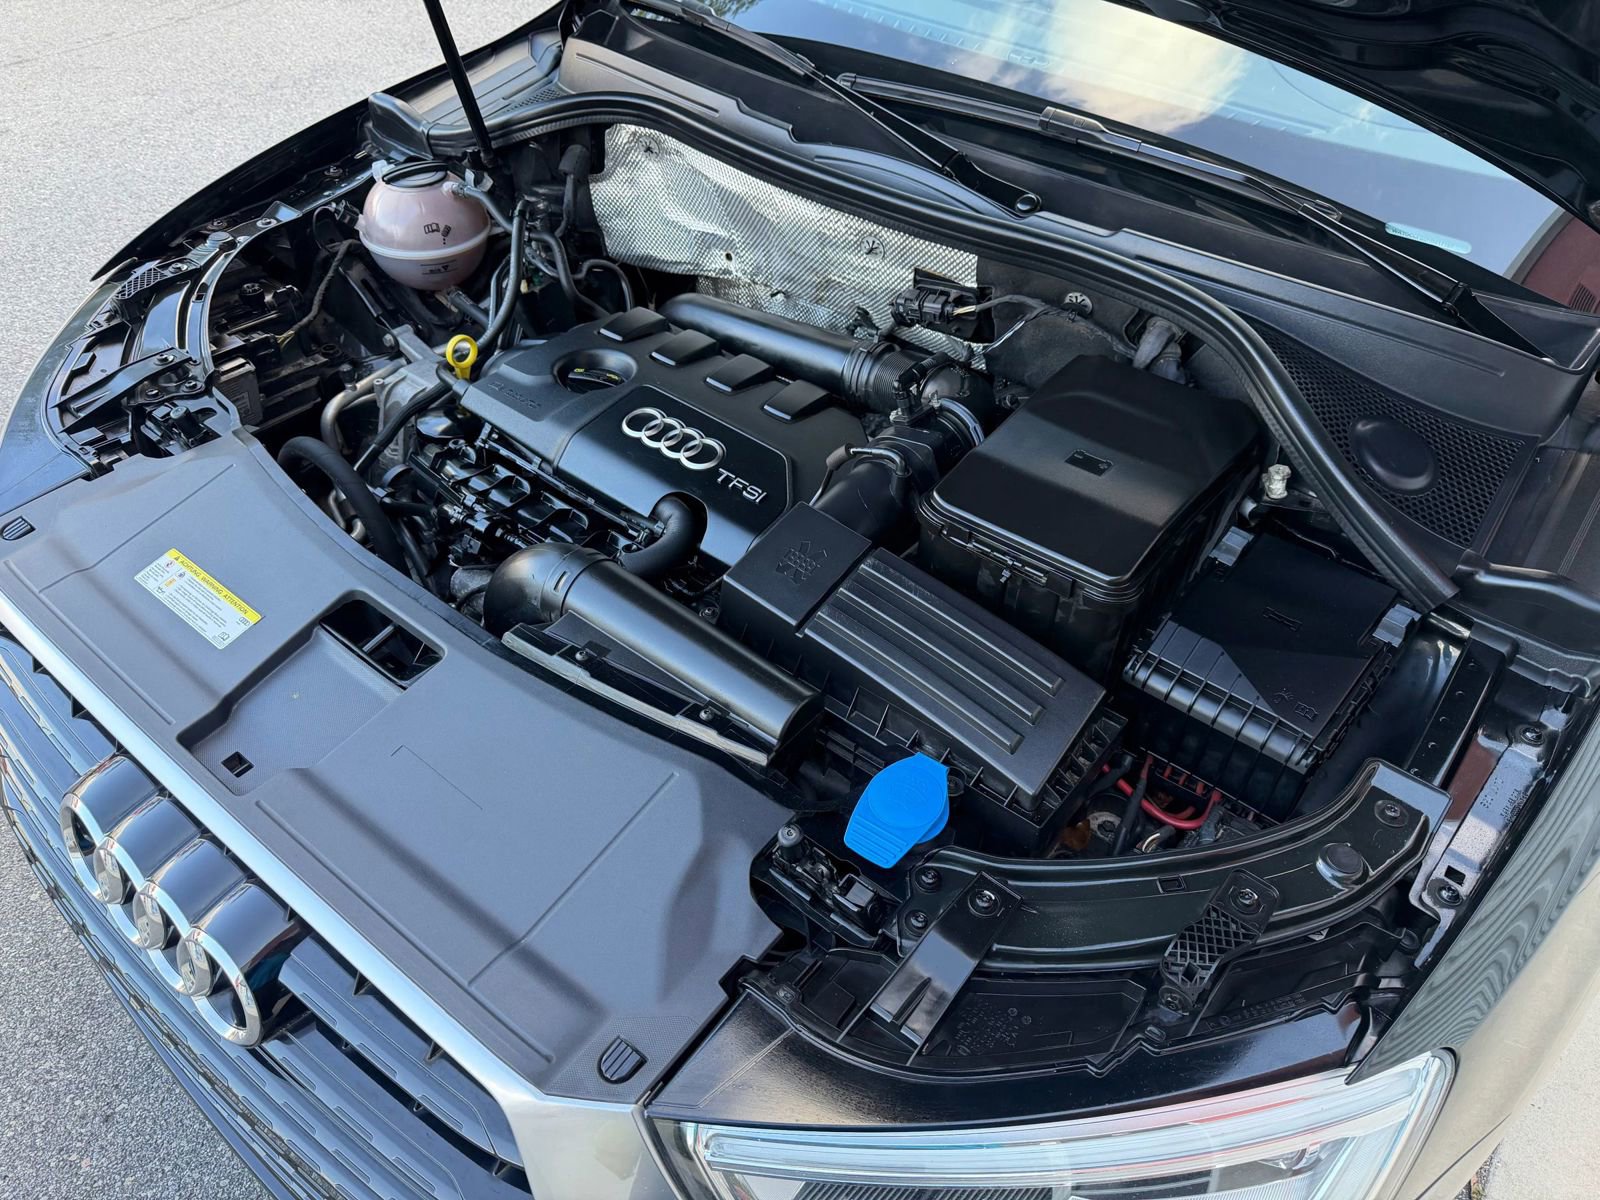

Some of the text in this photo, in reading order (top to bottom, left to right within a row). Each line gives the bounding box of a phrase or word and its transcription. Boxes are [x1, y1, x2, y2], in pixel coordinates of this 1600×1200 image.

[716, 467, 768, 505] TFSI
[180, 560, 202, 577] ACHTUNG
[201, 576, 224, 595] WARNING
[223, 593, 249, 615] ATTENTION
